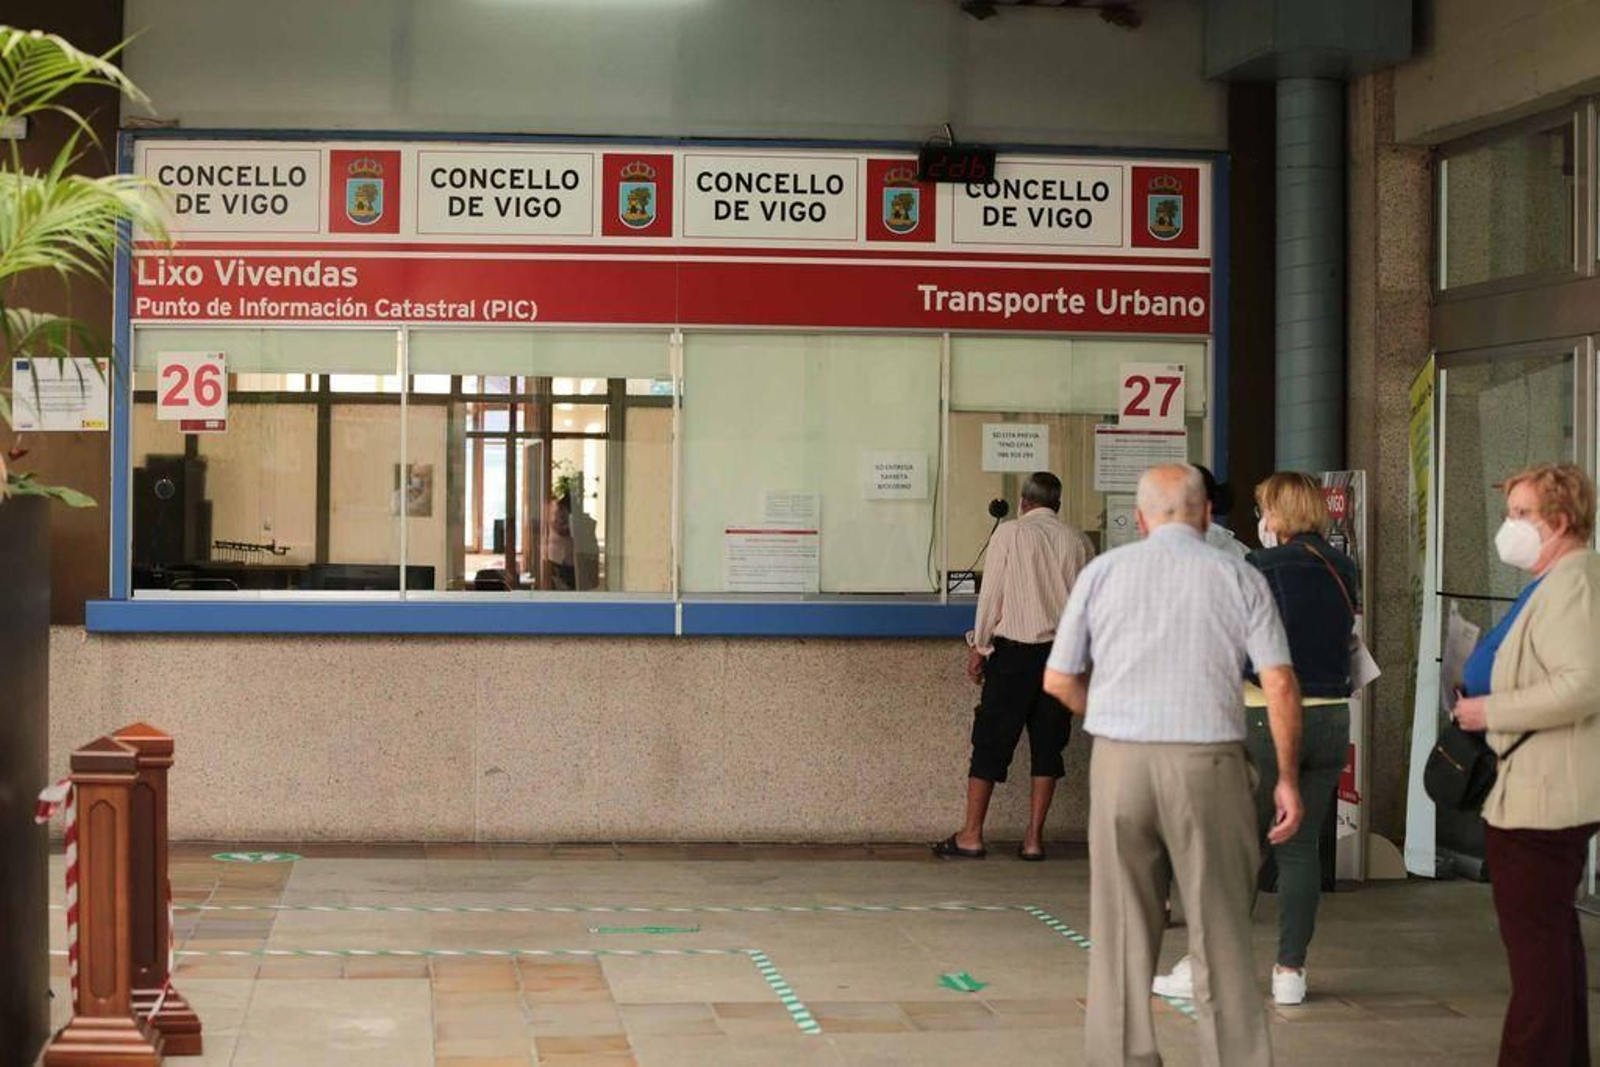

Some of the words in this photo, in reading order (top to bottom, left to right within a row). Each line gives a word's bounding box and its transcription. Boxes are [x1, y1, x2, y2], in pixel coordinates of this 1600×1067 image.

[158, 165, 307, 187] CONCELLO
[431, 167, 579, 190] CONCELLO
[696, 172, 844, 195] CONCELLO
[966, 179, 1110, 202] CONCELLO
[175, 194, 211, 215] DE
[221, 194, 289, 215] VIGO
[448, 196, 484, 217] DE
[495, 197, 562, 218] VIGO
[714, 200, 749, 220] DE
[760, 201, 827, 222] VIGO
[983, 207, 1017, 227] DE
[1027, 208, 1092, 229] VIGO
[136, 260, 204, 287] Lixo
[215, 260, 358, 287] Vivendas
[136, 299, 200, 317] Punto
[206, 300, 232, 318] de
[240, 299, 368, 318] Información
[375, 300, 475, 318] Catastral
[483, 300, 538, 321] (PIC)
[918, 284, 1085, 318] Transporte
[1096, 288, 1205, 317] Urbano
[162, 364, 222, 407] 26
[1123, 375, 1182, 418] 27
